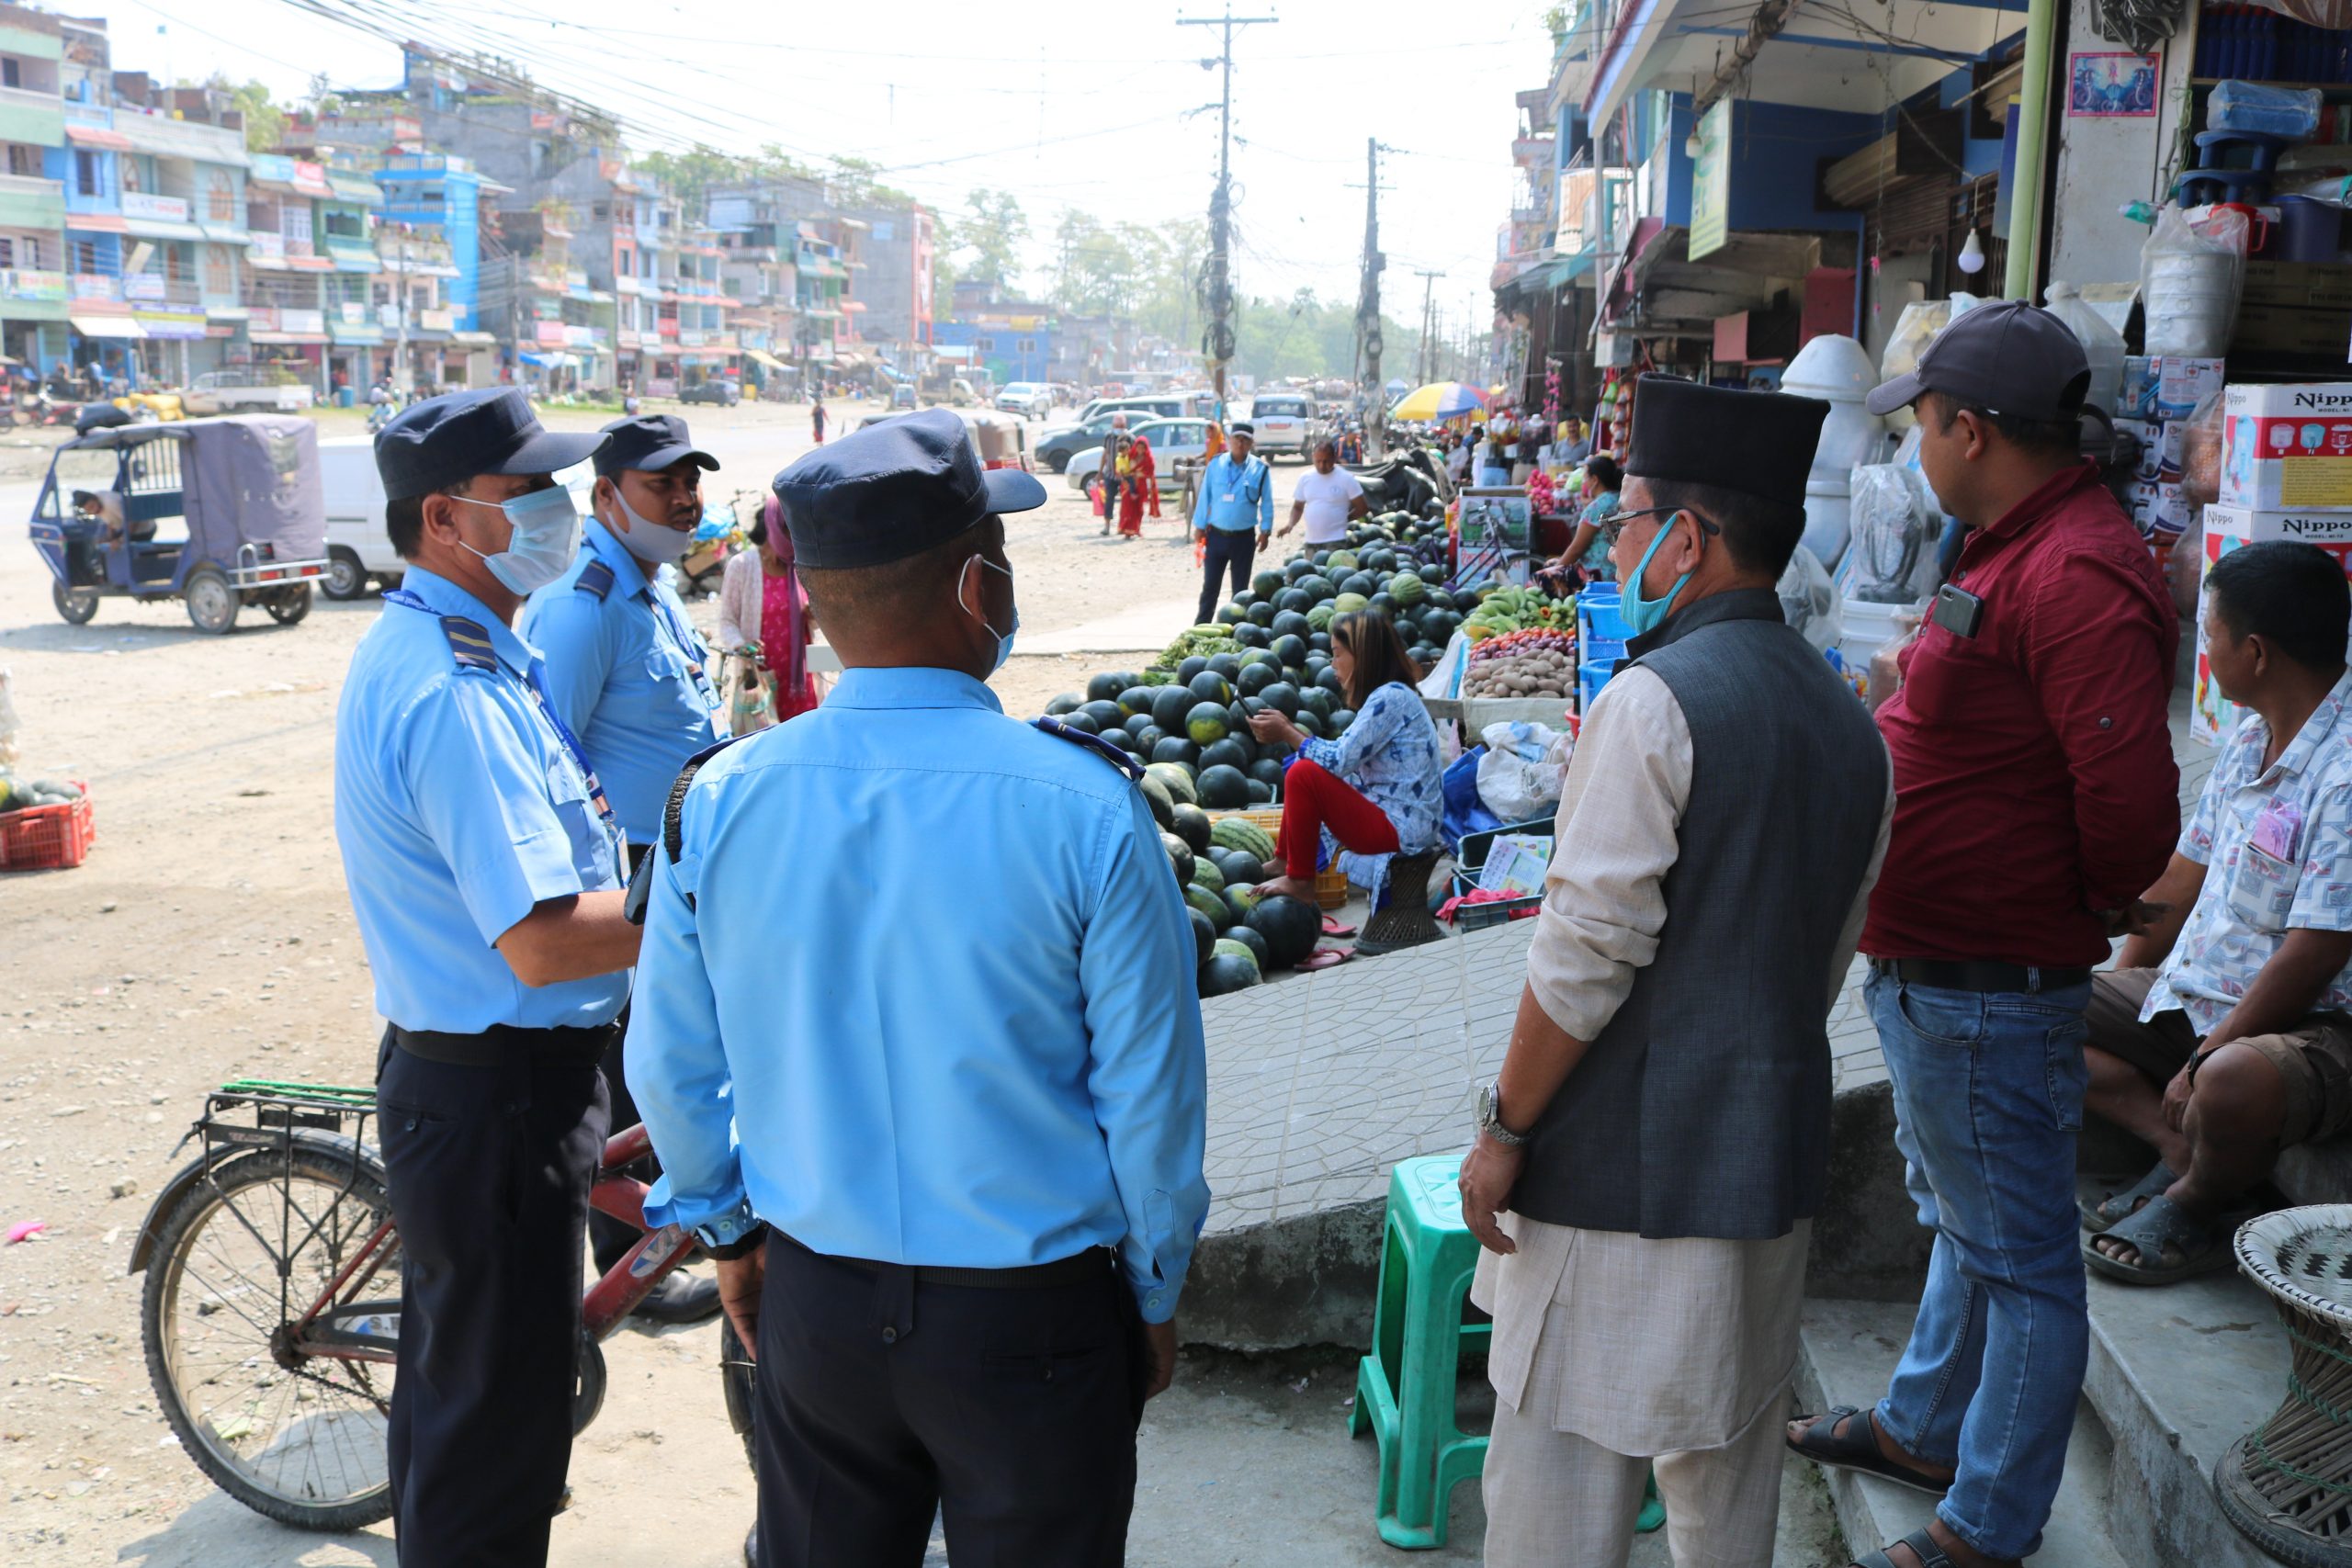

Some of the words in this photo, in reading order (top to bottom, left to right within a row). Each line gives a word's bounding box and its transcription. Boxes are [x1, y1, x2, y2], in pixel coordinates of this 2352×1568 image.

[2227, 392, 2247, 408] Nippo
[2294, 392, 2352, 409] Nipp
[2207, 510, 2233, 525] Nippo
[2282, 518, 2352, 535] Nippo
